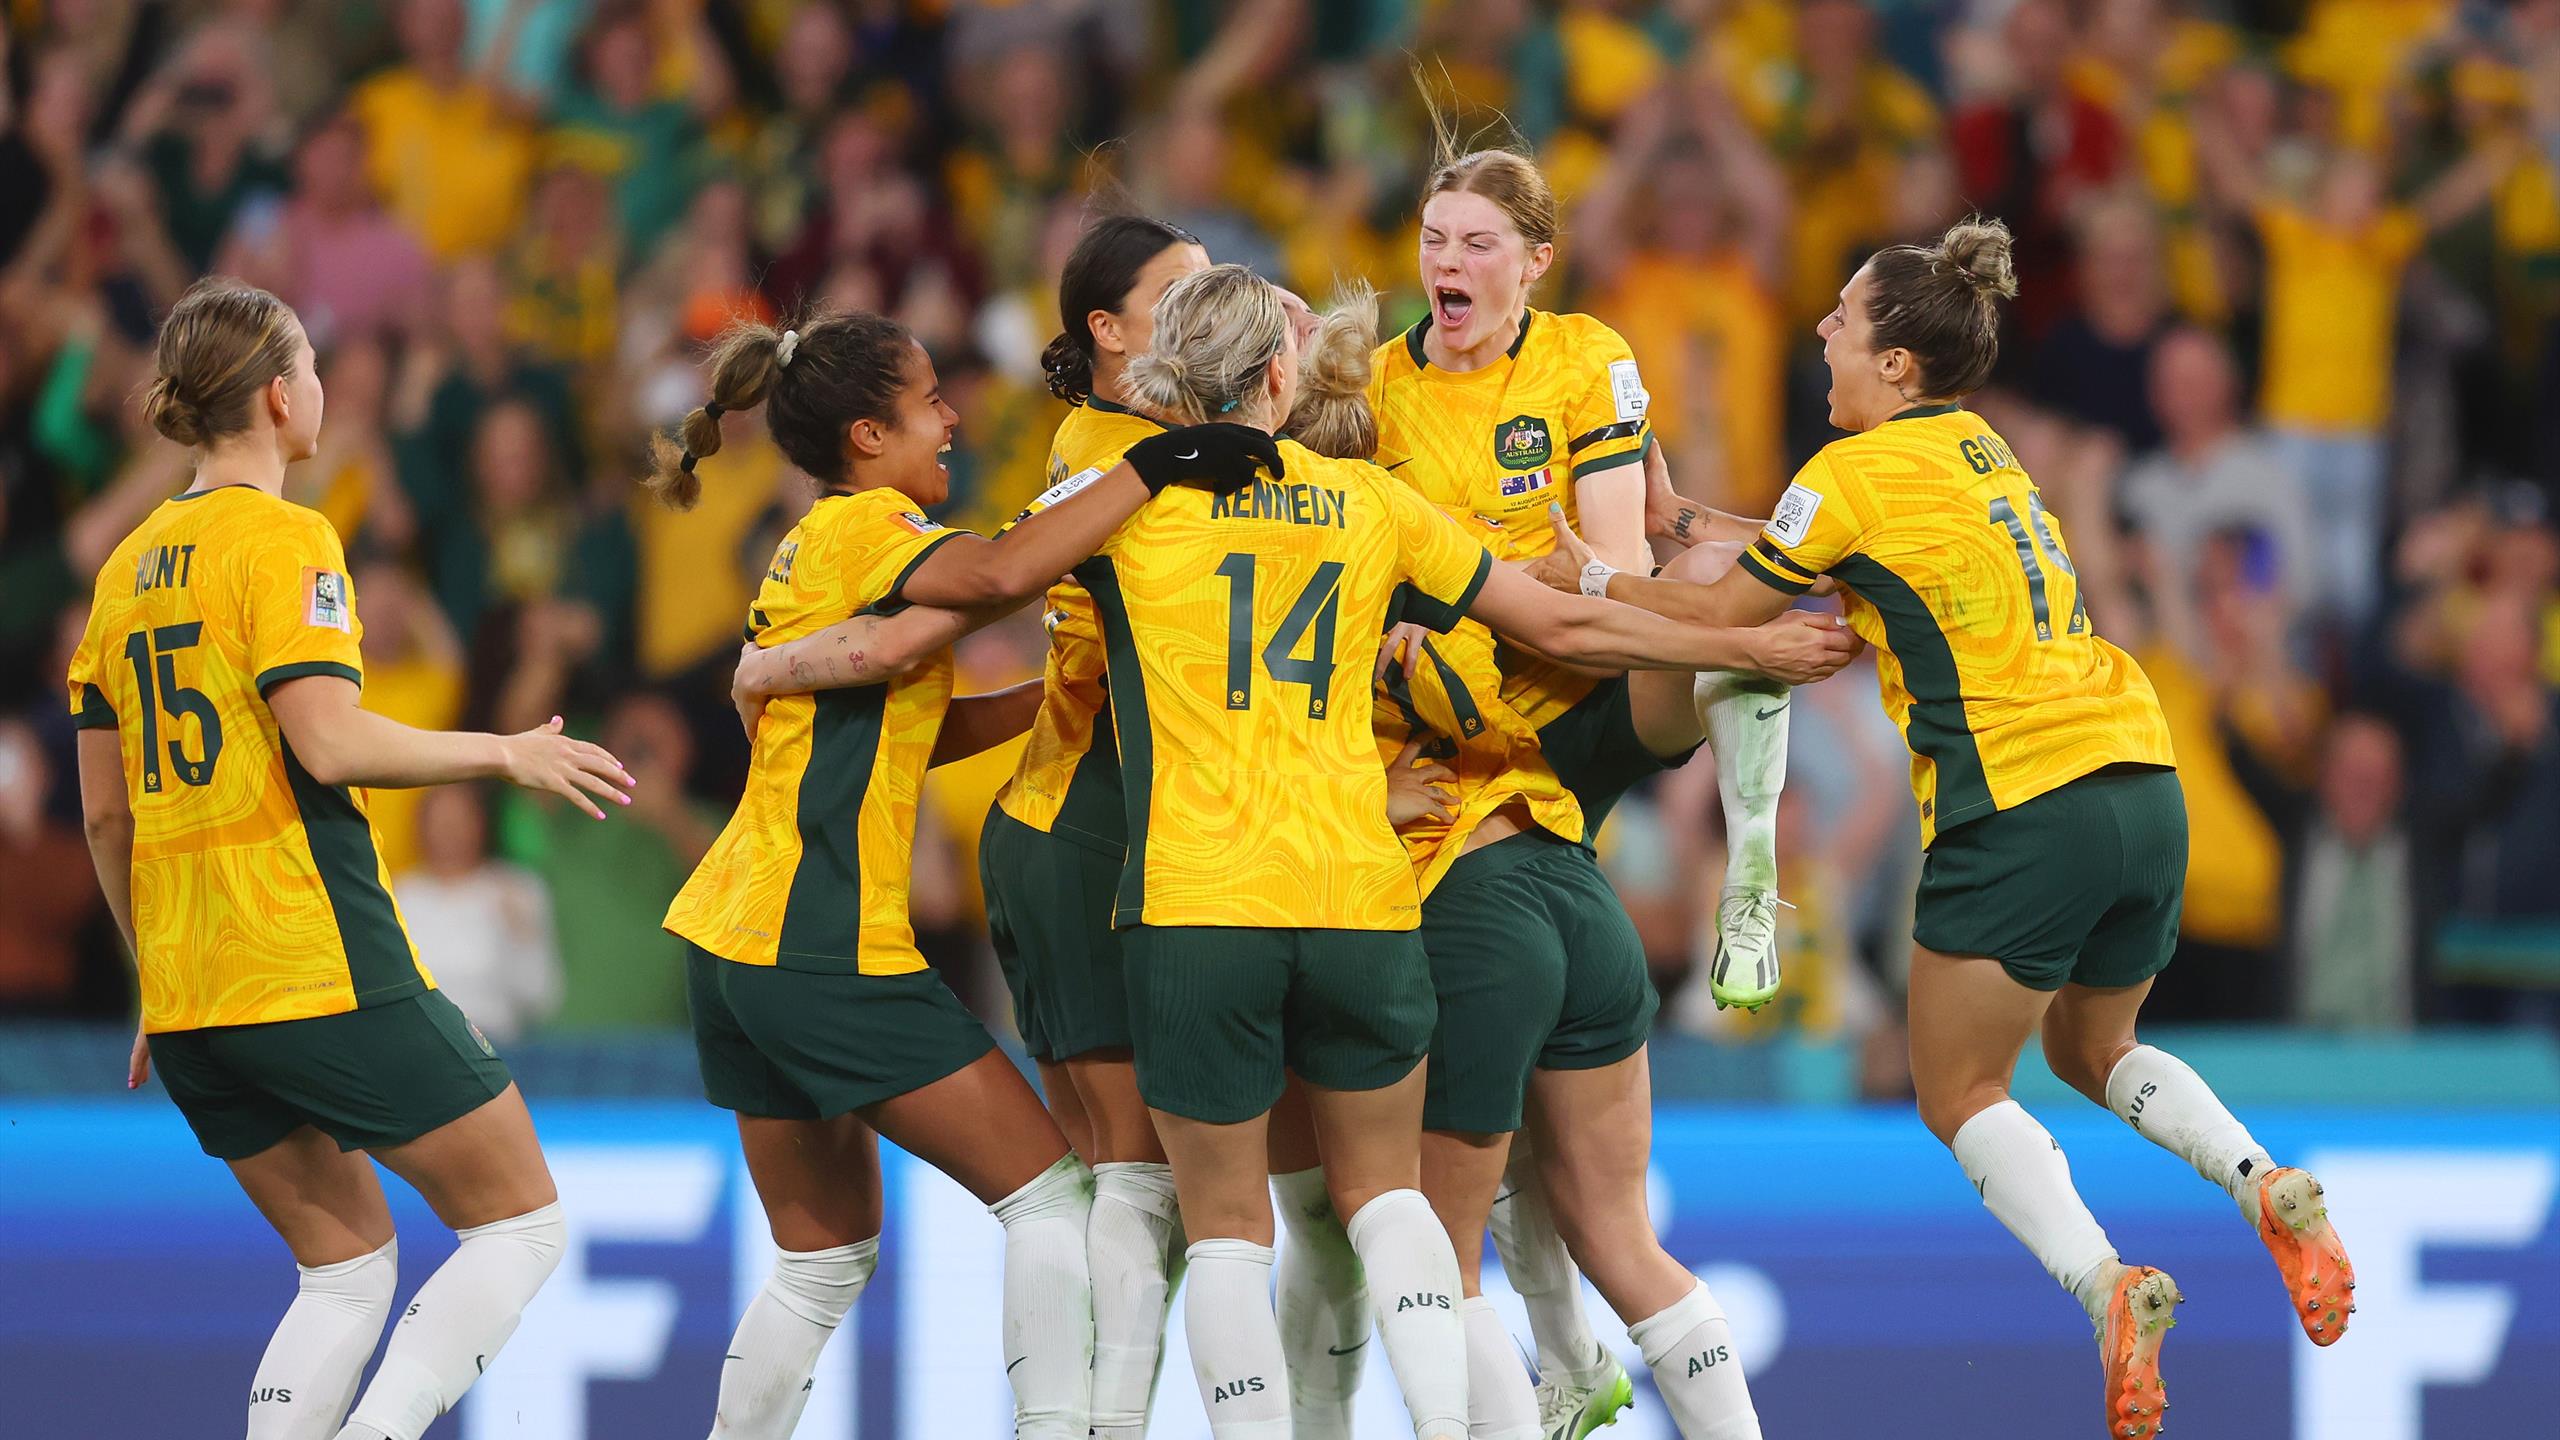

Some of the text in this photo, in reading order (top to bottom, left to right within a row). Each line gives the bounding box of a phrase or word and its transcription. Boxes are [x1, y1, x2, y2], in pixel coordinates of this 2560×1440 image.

[1506, 448, 1543, 457] AUSTRALIA
[1211, 477, 1345, 529] KENNEDY
[135, 544, 196, 597] HUNT
[1214, 552, 1345, 720] 14
[124, 620, 223, 793] 15
[2129, 1081, 2158, 1131] AUS
[1396, 1292, 1451, 1313] AUS
[1688, 1345, 1729, 1379] AUS
[250, 1387, 293, 1406] AUS
[1214, 1376, 1266, 1404] AUS
